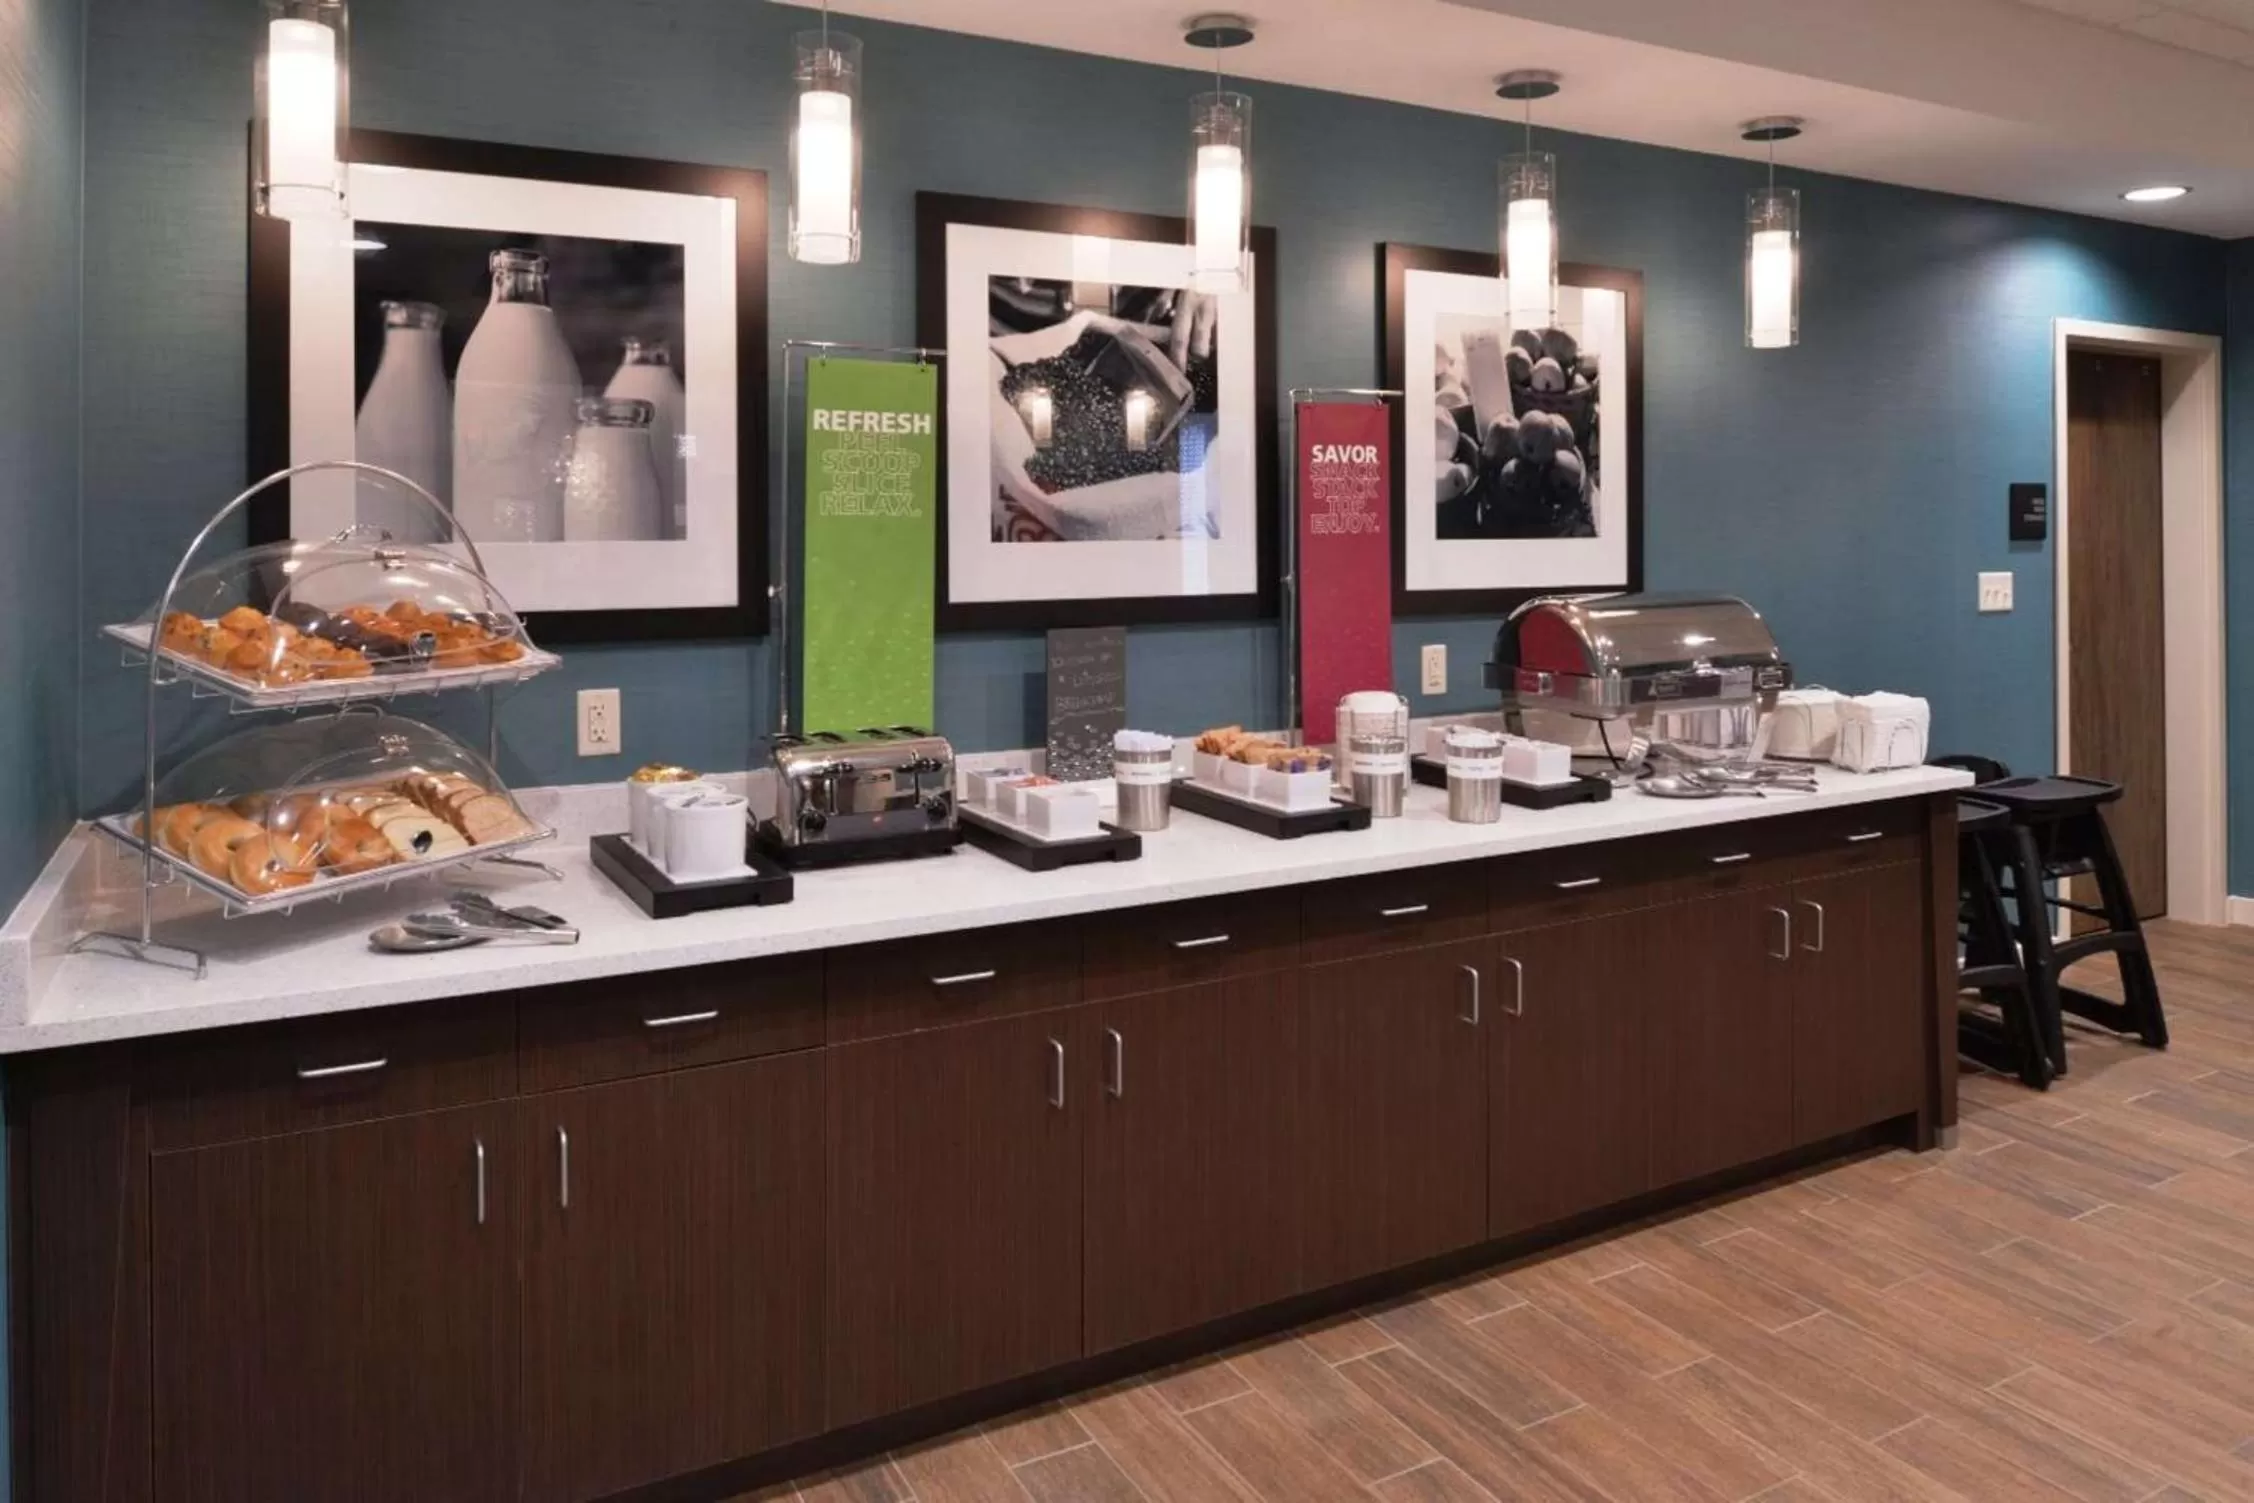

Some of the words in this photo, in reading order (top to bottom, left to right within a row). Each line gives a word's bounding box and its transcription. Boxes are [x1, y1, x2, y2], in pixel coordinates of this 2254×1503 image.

[812, 408, 932, 435] REFRESH
[822, 449, 921, 474] SCOOP
[1311, 444, 1378, 463] SAVOR
[832, 472, 911, 494] SLICE
